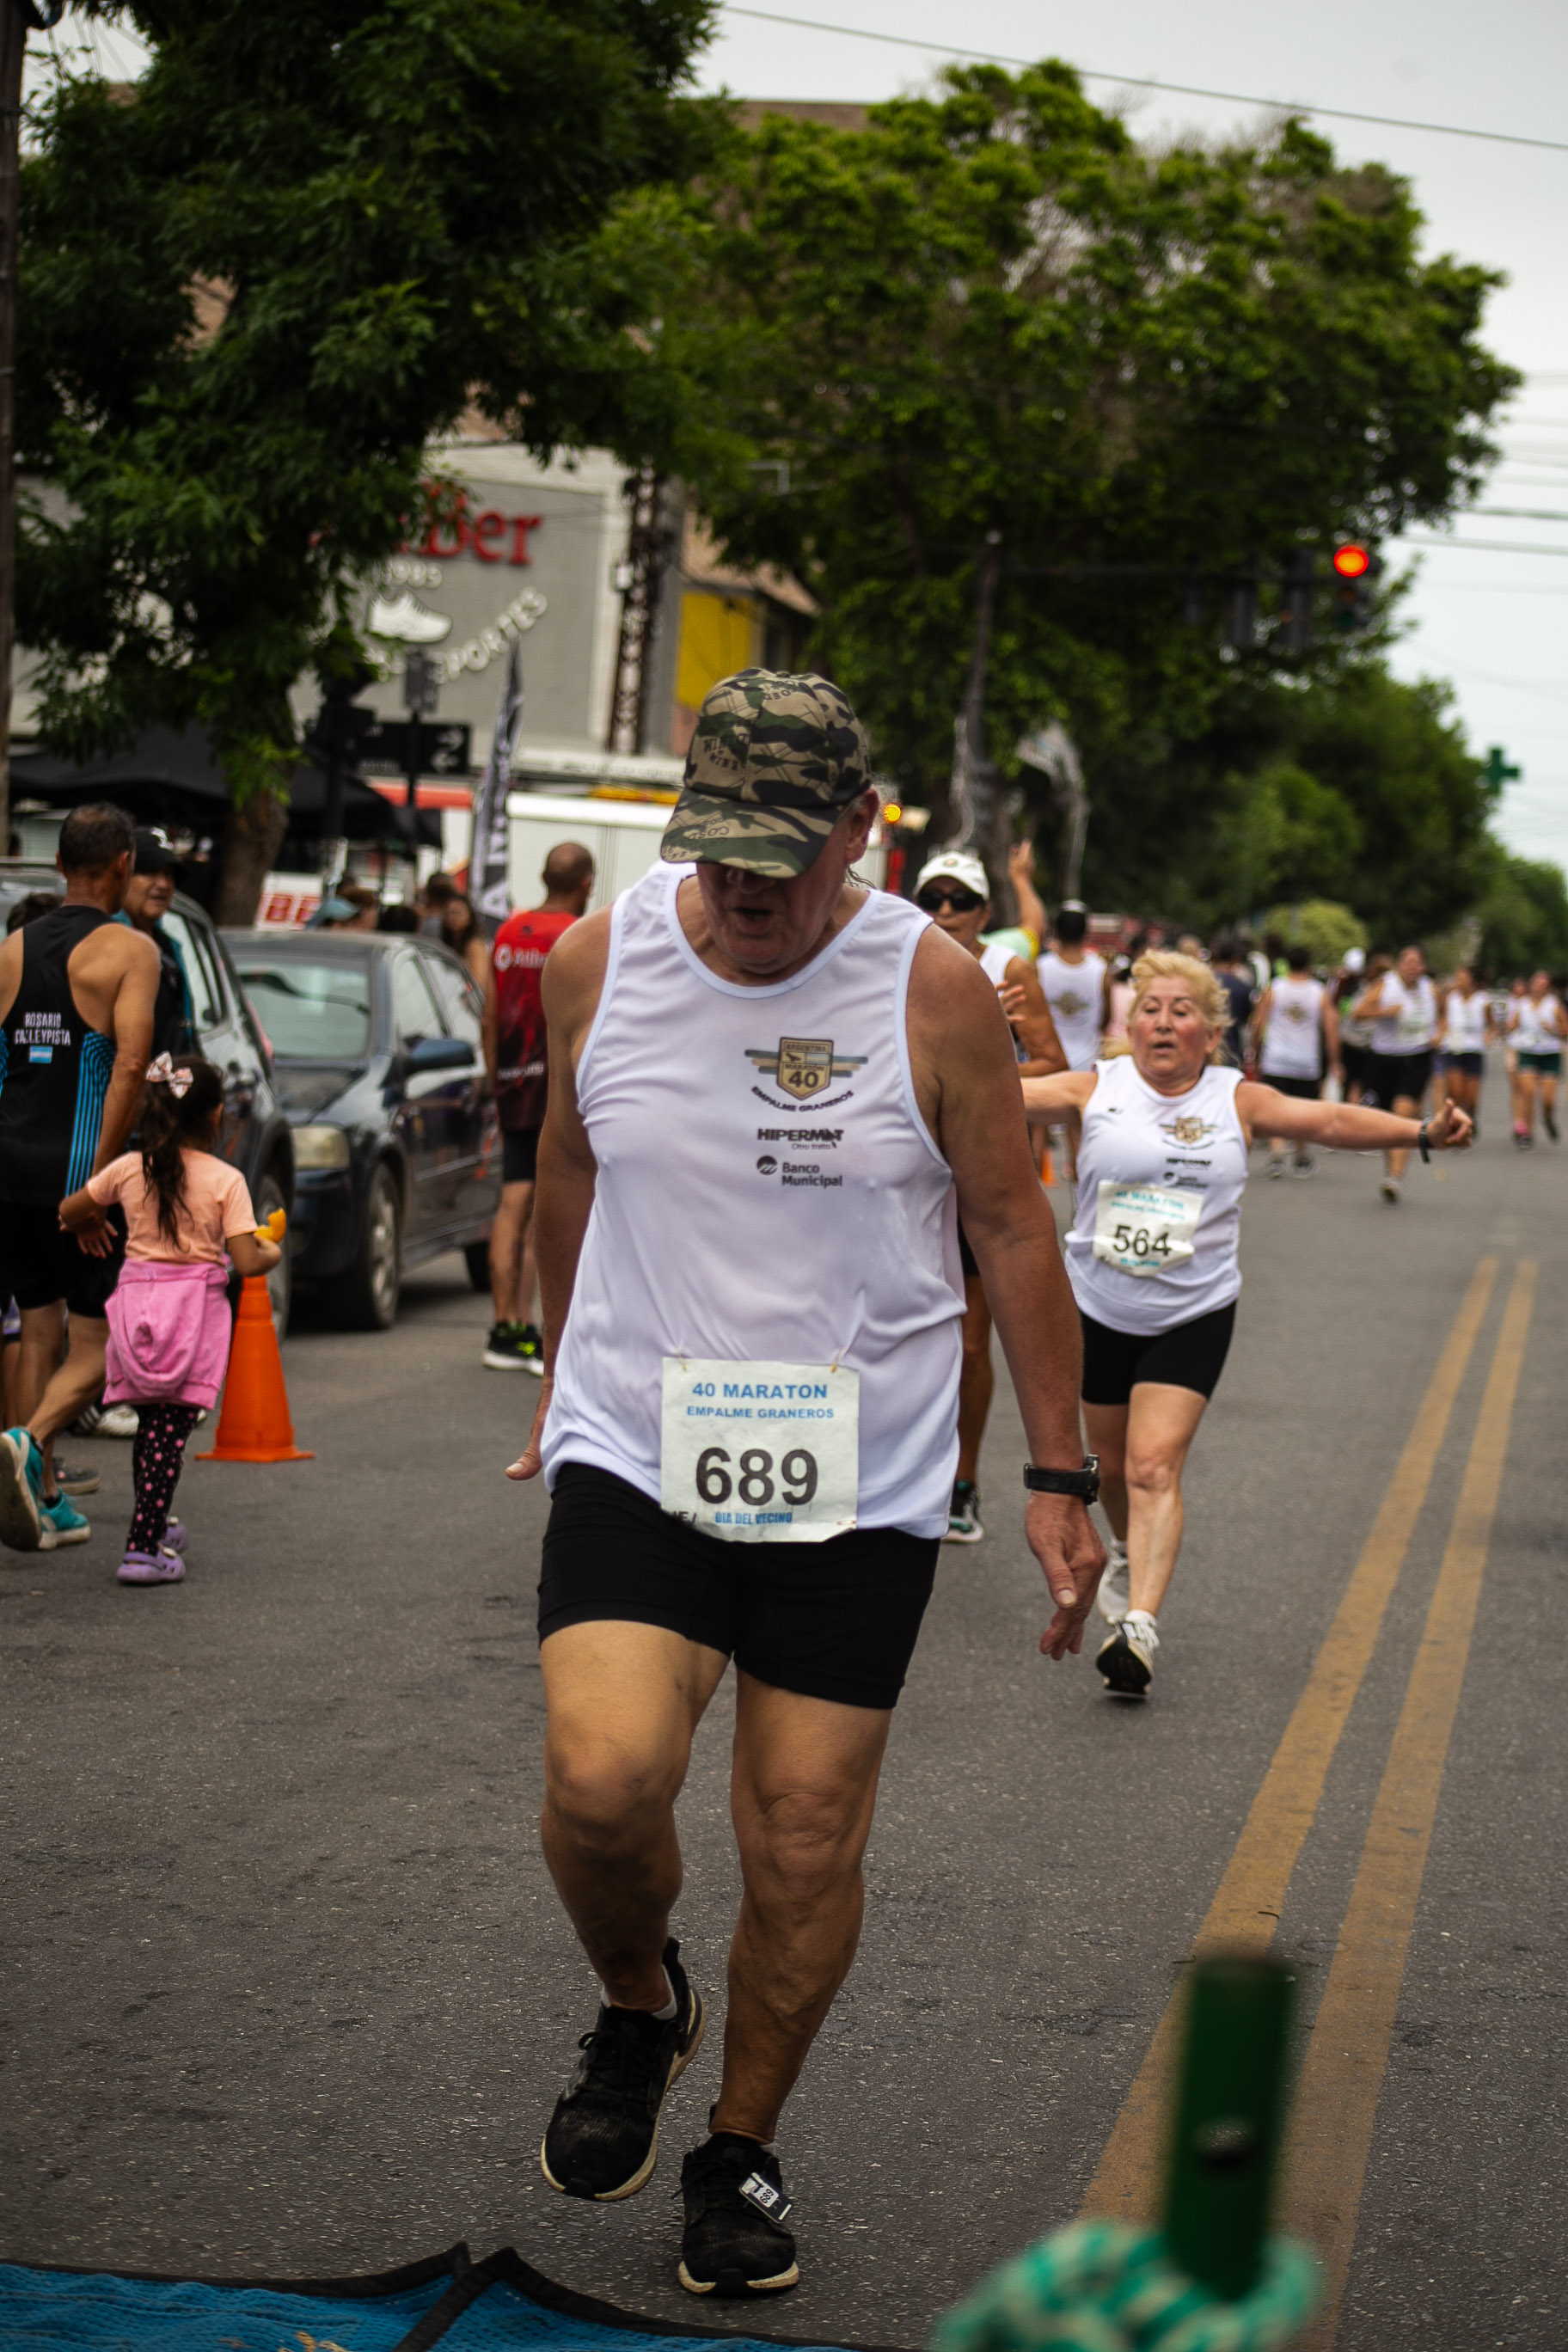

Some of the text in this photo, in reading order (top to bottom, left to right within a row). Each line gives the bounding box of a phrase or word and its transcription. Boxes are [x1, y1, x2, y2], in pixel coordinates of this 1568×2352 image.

[24, 1012, 62, 1028] ROSARIO
[787, 1070, 819, 1089] 40
[751, 1086, 854, 1112] EMPALME GRANEROS
[781, 1162, 820, 1174] Banco
[781, 1174, 843, 1189] Municipal
[1112, 1224, 1172, 1257] 564
[692, 1383, 828, 1399] 40 MARATON
[687, 1406, 835, 1418] EMPALME GRANEROS
[695, 1447, 818, 1506] 689
[714, 1511, 793, 1525] DIA DEL VECINO
[759, 2188, 774, 2203] 689
